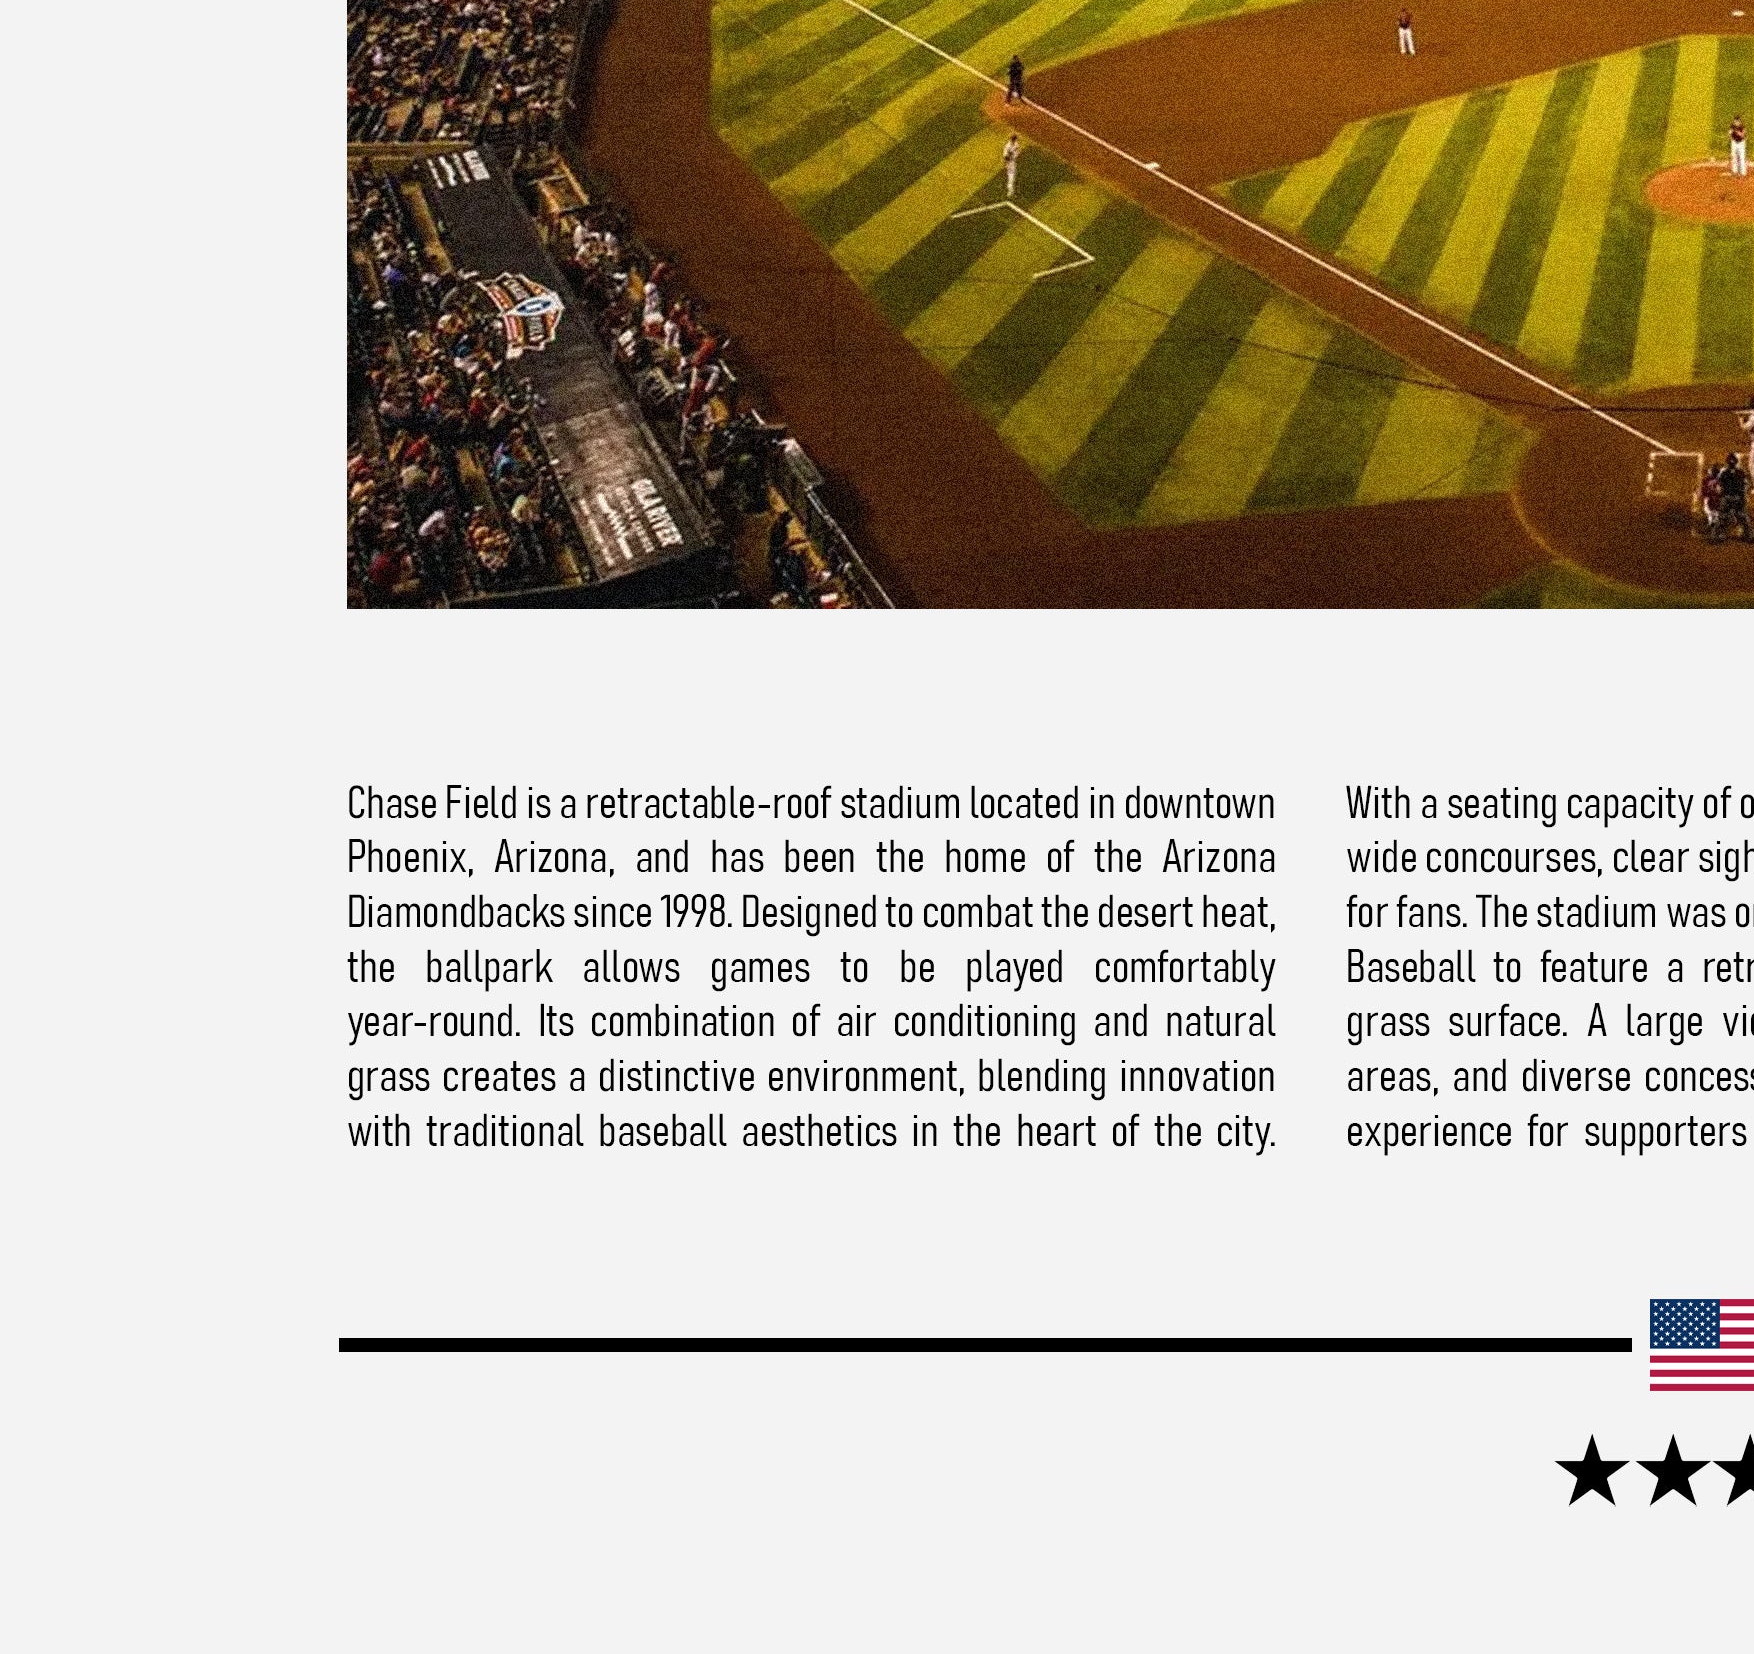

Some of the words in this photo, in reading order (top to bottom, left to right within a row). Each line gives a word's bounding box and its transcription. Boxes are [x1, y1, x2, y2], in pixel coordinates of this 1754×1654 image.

[349, 785, 436, 818] Chase
[447, 785, 516, 818] Field
[529, 787, 550, 818] is
[561, 795, 575, 818] a
[588, 786, 831, 818] retractable-roof
[841, 786, 959, 818] stadium
[972, 786, 1078, 818] located
[1091, 787, 1113, 818] in
[1126, 786, 1273, 818] downtown
[1346, 786, 1409, 818] With
[1422, 795, 1436, 818] a
[1448, 787, 1556, 827] seating
[1568, 787, 1693, 827] capacity
[1704, 786, 1731, 818] of
[349, 894, 564, 927] Diamondbacks
[574, 896, 651, 927] since
[661, 894, 732, 927] 1998.
[743, 895, 876, 936] Designed
[886, 897, 912, 927] to
[924, 895, 1033, 927] combat
[1042, 895, 1088, 927] the
[1099, 895, 1193, 927] desert
[1203, 895, 1275, 932] heat,
[1347, 895, 1388, 927] for
[1397, 895, 1467, 927] fans.
[1476, 895, 1527, 927] The
[1537, 895, 1655, 927] stadium
[1667, 904, 1725, 927] was
[348, 1114, 409, 1146] with
[427, 1114, 583, 1146] traditional
[601, 1114, 727, 1146] baseball
[743, 1114, 896, 1146] aesthetics
[914, 1115, 936, 1146] in
[954, 1114, 1000, 1146] the
[1019, 1114, 1096, 1146] heart
[1113, 1114, 1139, 1146] of
[1155, 1114, 1201, 1146] the
[1218, 1115, 1275, 1156] city.
[1348, 1115, 1511, 1156] experience
[1528, 1114, 1568, 1146] for
[1585, 1116, 1746, 1155] supporters
